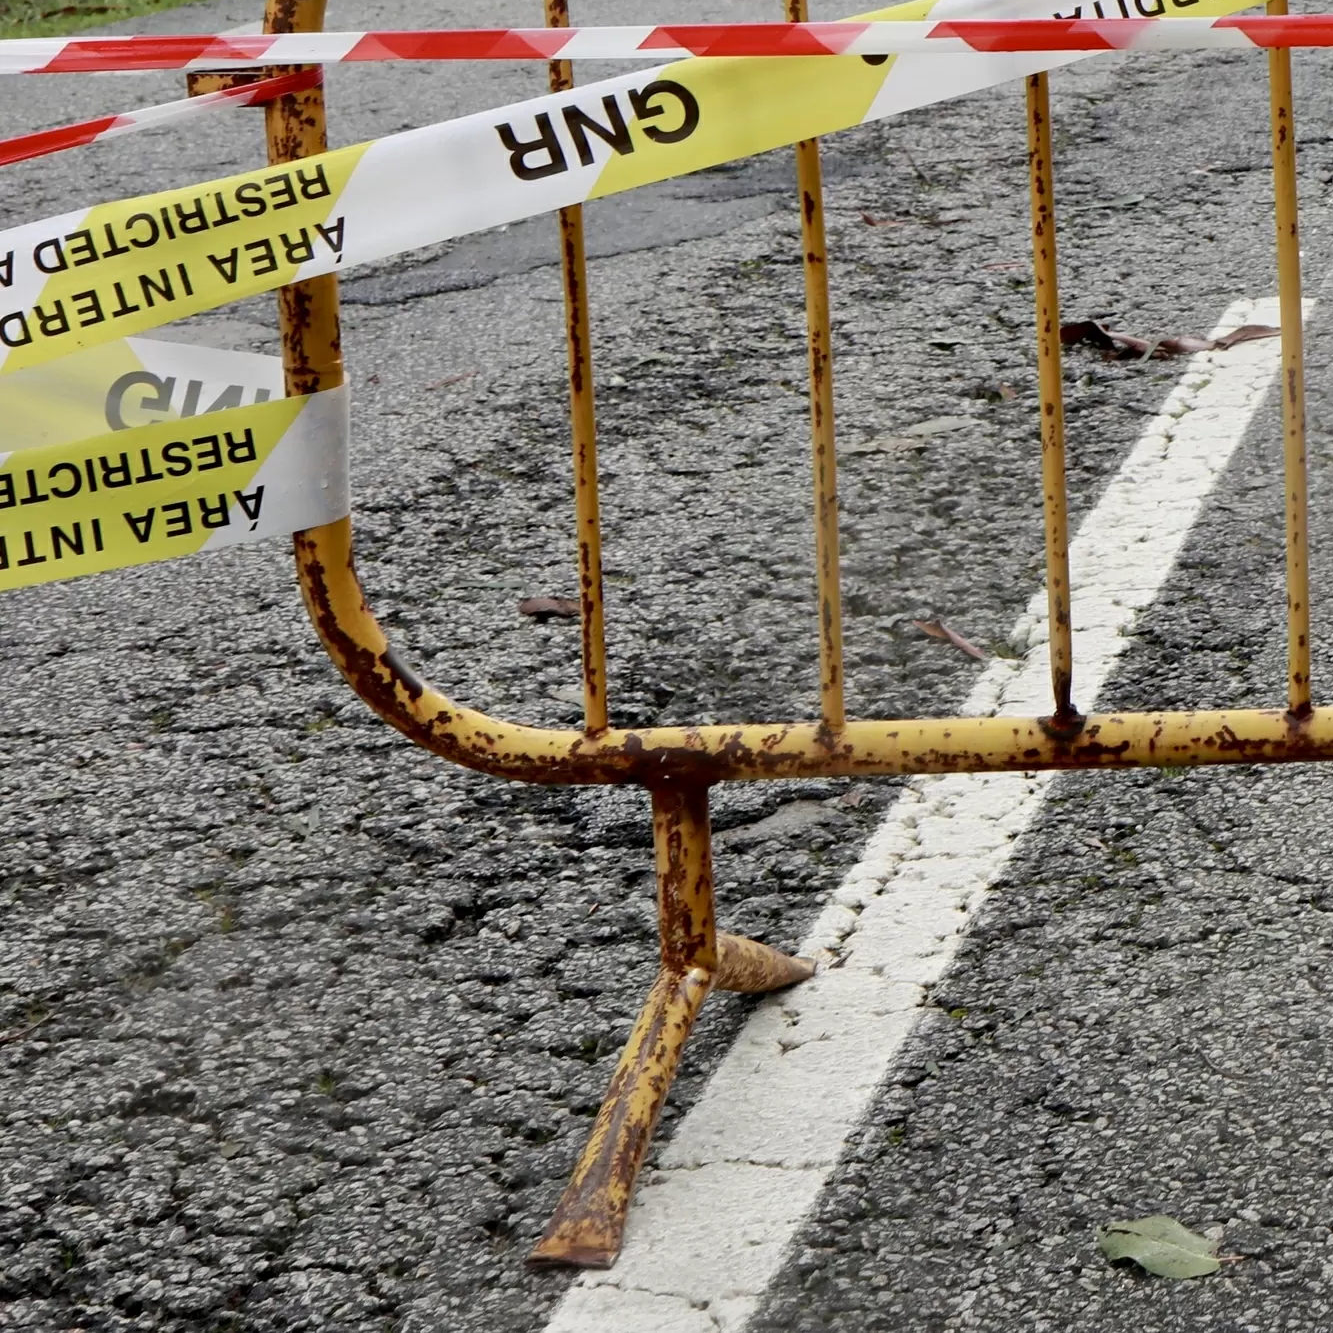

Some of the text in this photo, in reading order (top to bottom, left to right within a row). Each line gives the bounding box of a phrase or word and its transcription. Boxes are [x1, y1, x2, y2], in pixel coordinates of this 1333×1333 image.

[493, 78, 700, 181] GNR
[33, 164, 331, 274] RESTRICTED
[0, 216, 346, 348] ÁREA INTERD
[122, 485, 265, 545] ÁREA
